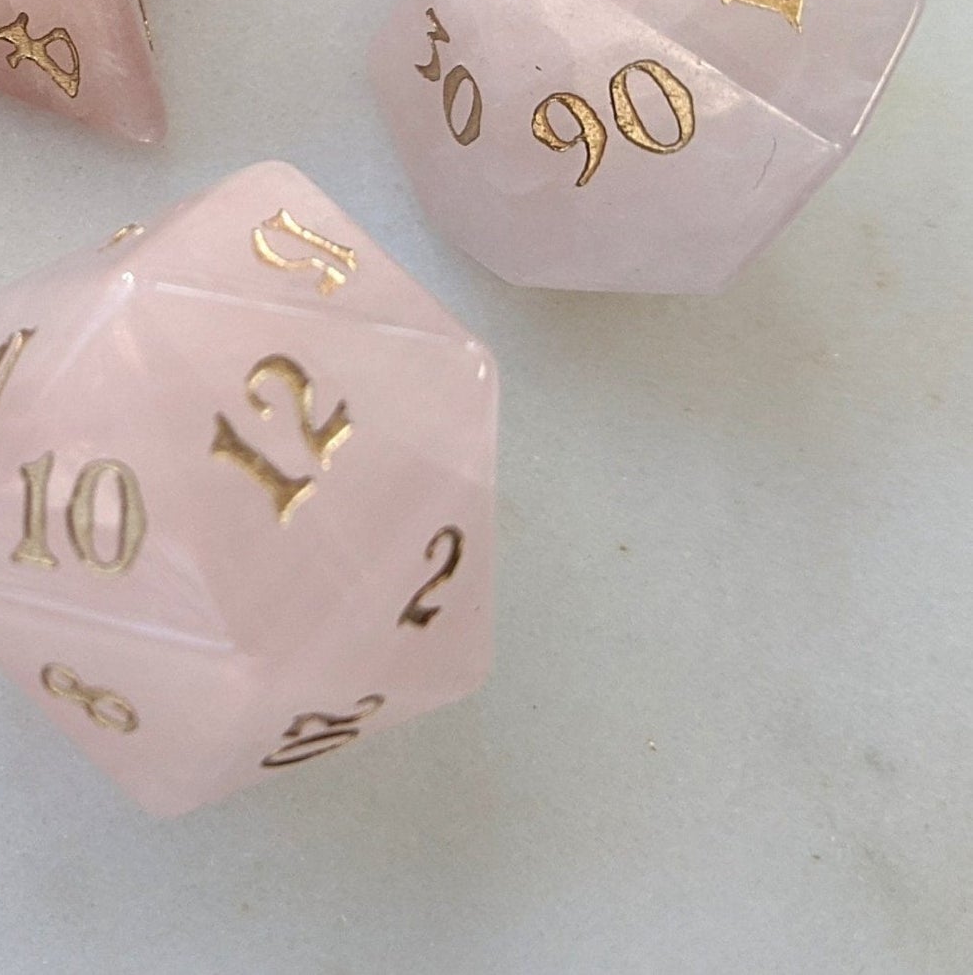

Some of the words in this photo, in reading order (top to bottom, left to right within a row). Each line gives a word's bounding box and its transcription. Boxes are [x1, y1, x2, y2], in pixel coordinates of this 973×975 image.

[415, 7, 483, 147] 30
[531, 59, 696, 187] 90
[210, 353, 354, 523] 12
[11, 451, 146, 575] 10
[397, 525, 465, 629] 2
[40, 662, 141, 736] 8
